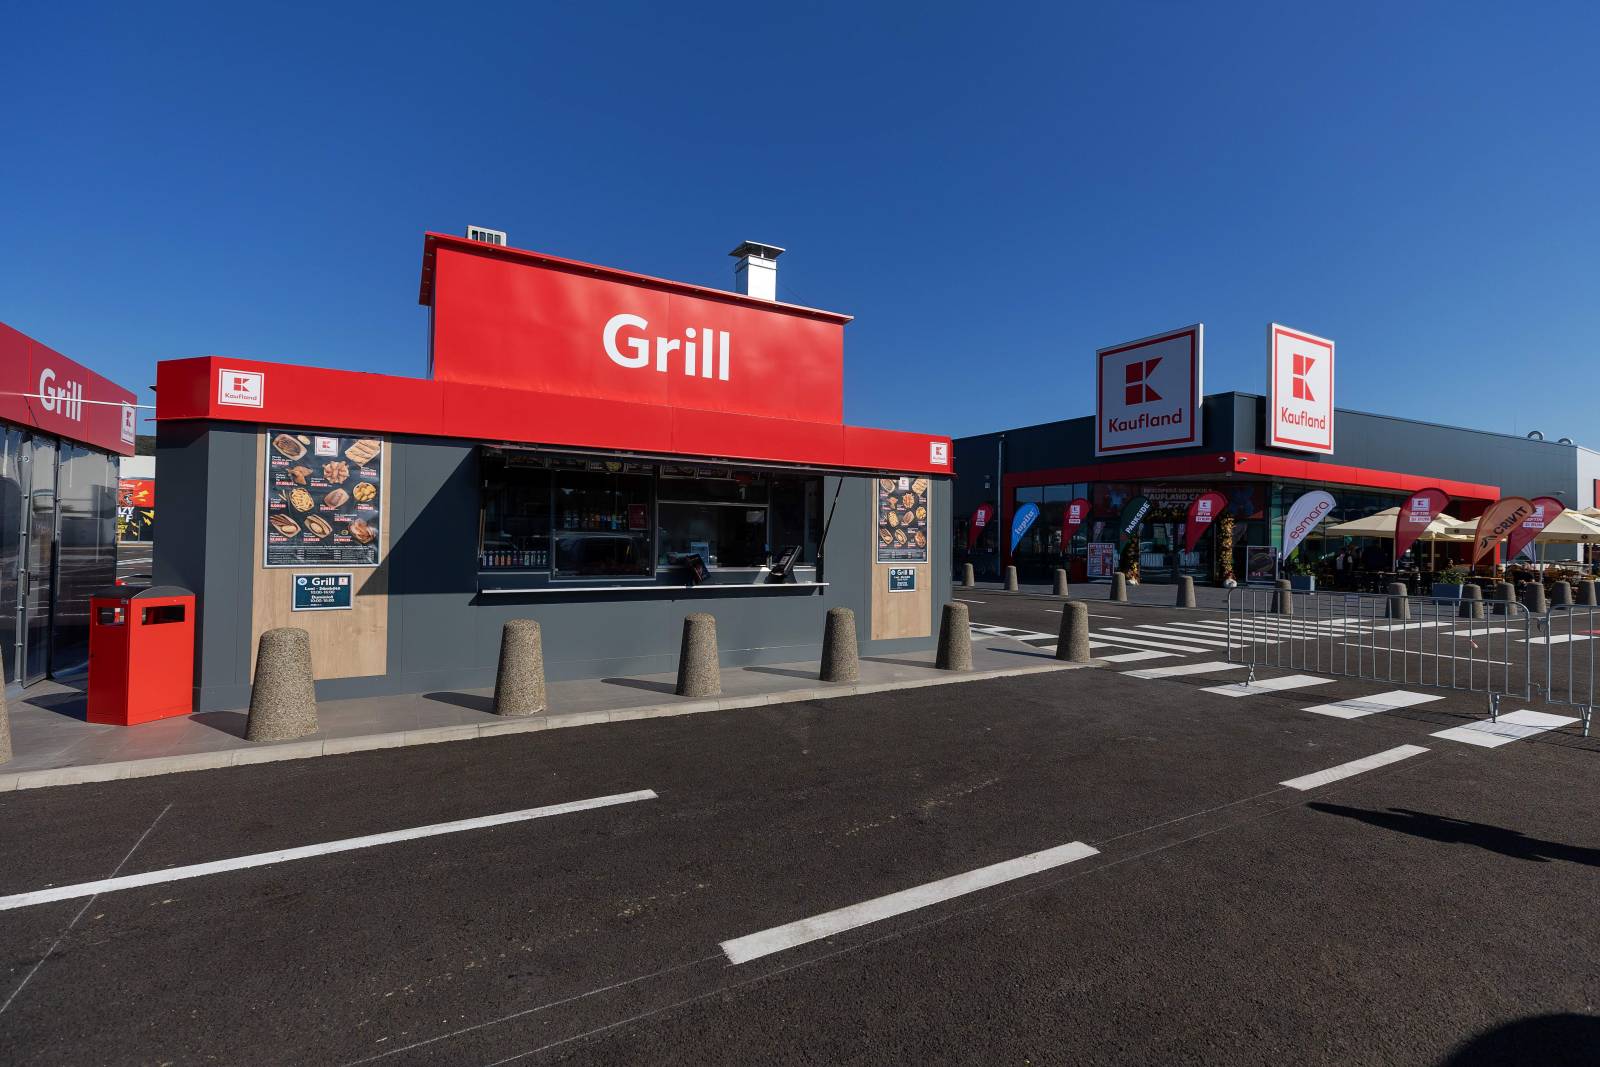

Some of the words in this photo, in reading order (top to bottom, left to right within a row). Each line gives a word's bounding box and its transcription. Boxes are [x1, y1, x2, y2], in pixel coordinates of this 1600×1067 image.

[603, 313, 730, 381] Grill
[39, 367, 82, 422] Grill
[224, 392, 258, 401] Kaufland
[1108, 407, 1183, 433] Kaufland
[1280, 406, 1327, 430] Kaufland
[1124, 500, 1151, 535] PARKSIDE
[1290, 501, 1330, 540] esmara
[1493, 505, 1528, 535] CRIVIT
[311, 577, 335, 586] Grill
